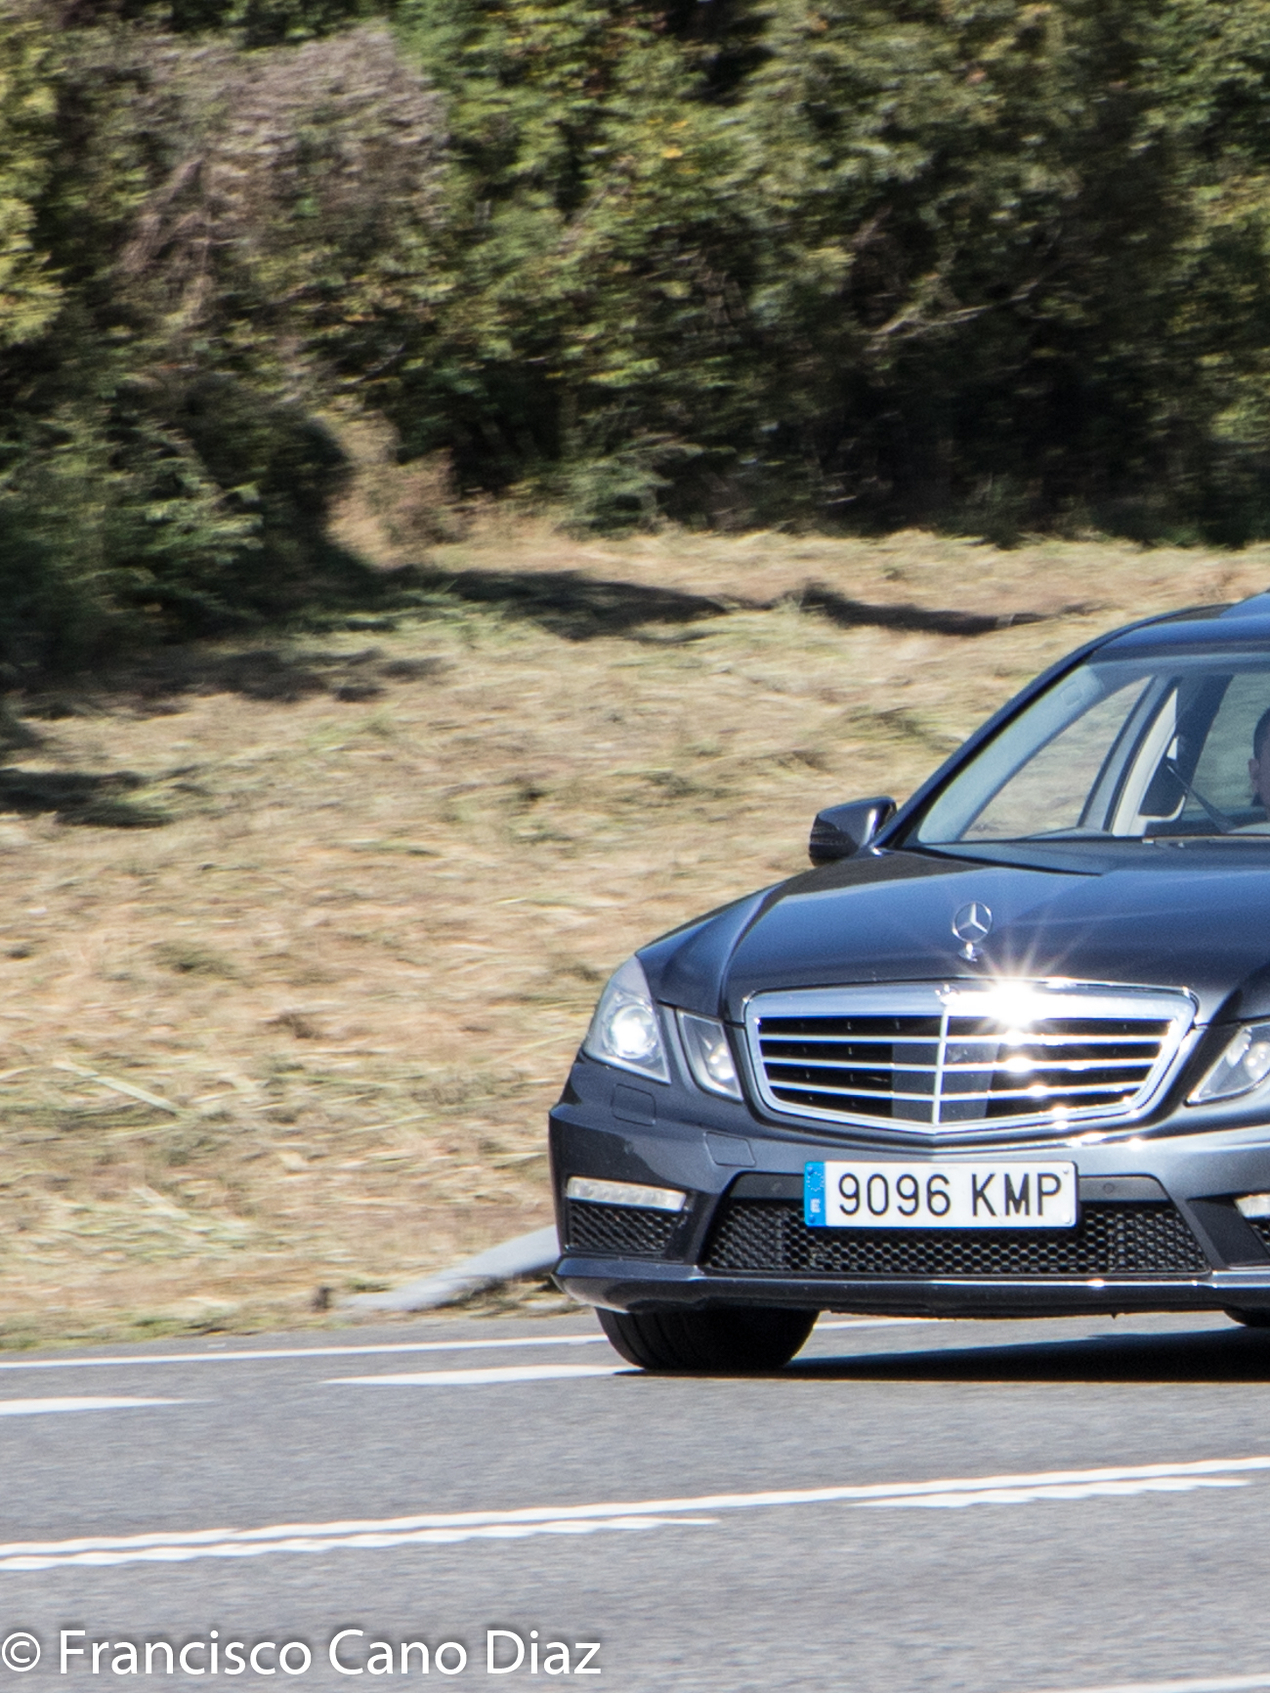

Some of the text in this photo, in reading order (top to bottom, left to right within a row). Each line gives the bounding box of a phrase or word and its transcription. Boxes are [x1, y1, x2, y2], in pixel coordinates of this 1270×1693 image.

[810, 1198, 820, 1213] E
[838, 1173, 1062, 1217] 9096 KMP
